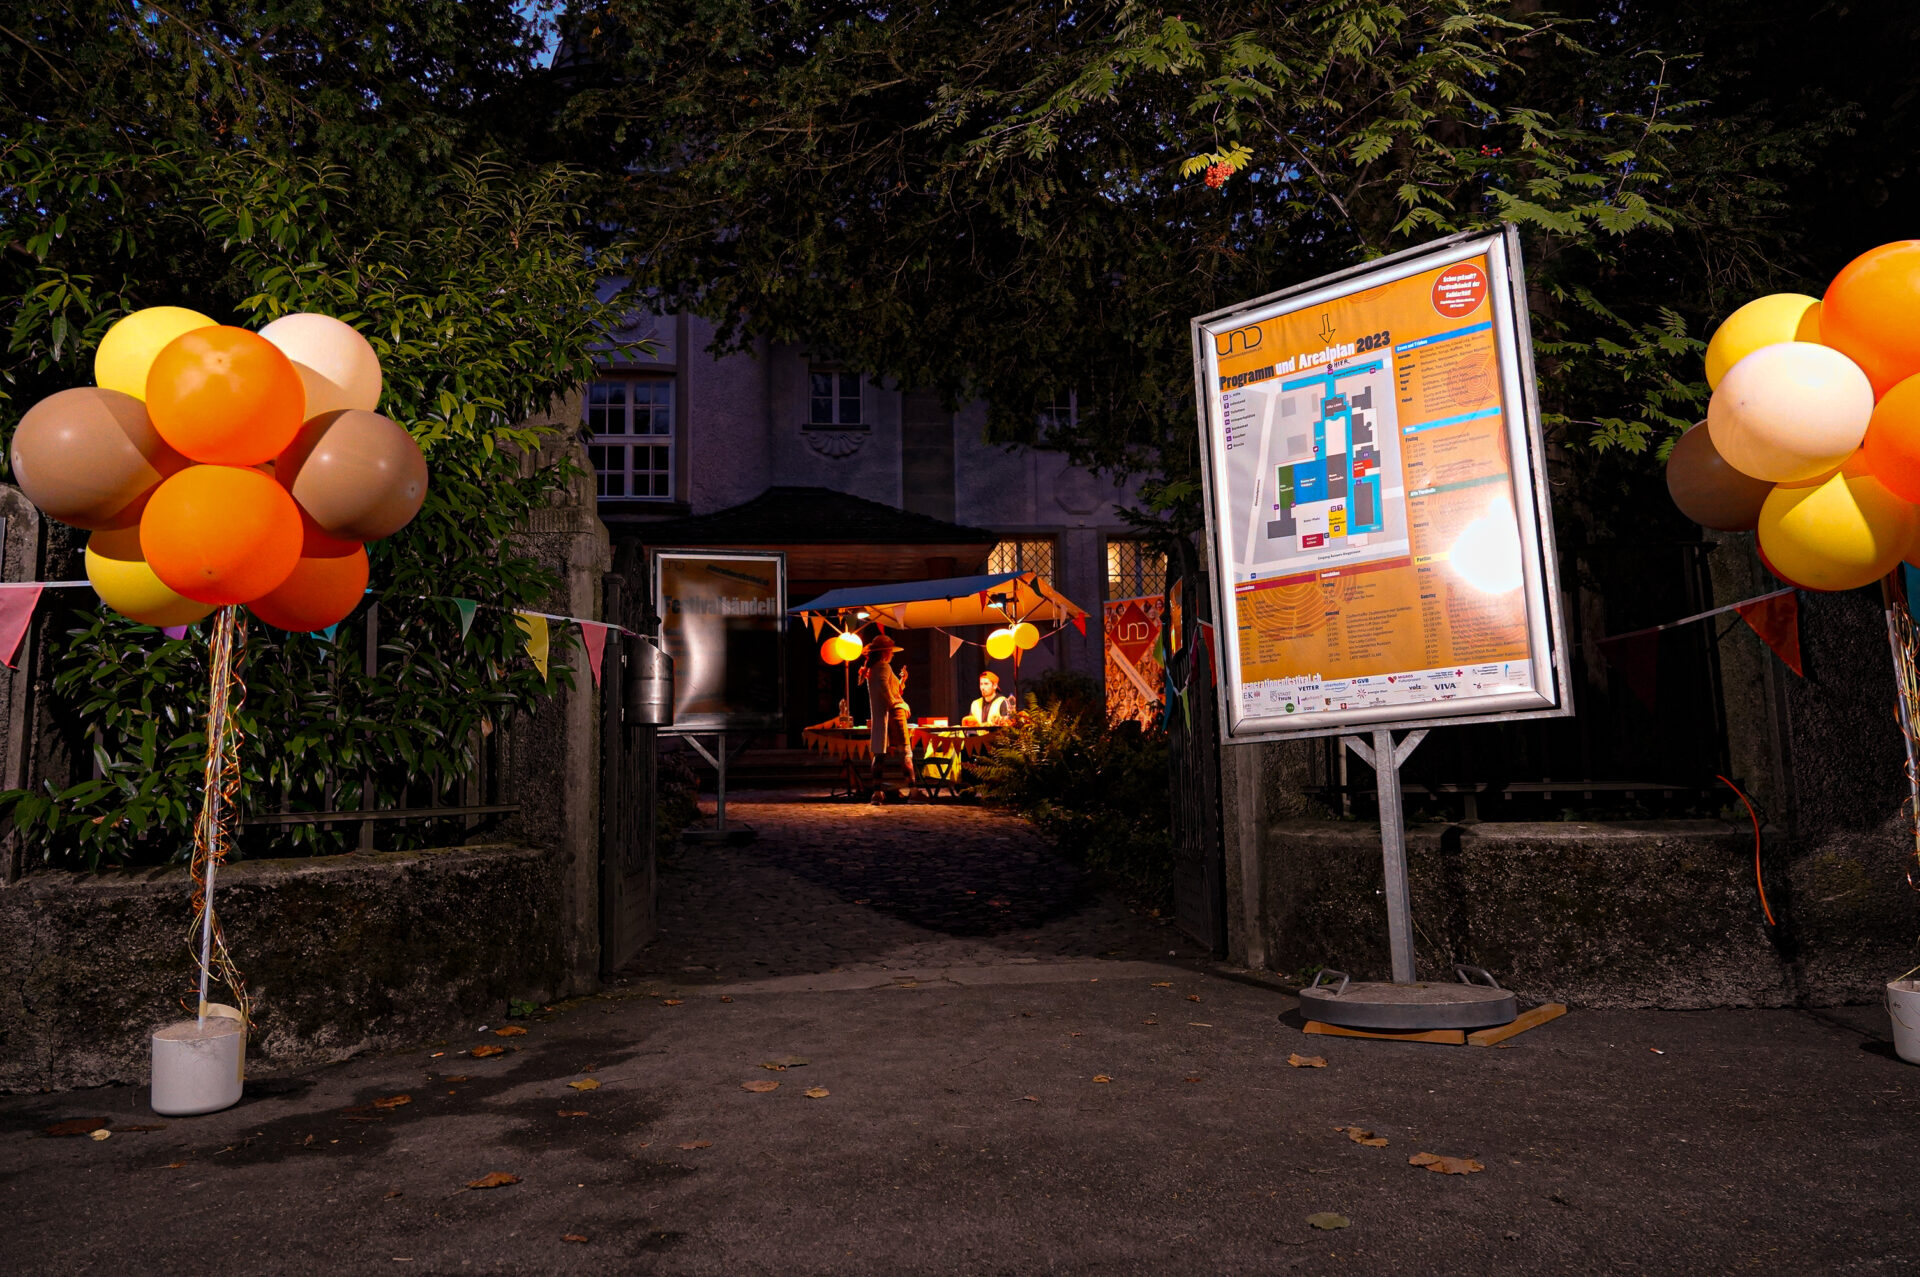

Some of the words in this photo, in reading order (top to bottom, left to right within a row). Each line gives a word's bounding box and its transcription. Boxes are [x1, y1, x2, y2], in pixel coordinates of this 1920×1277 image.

[1220, 365, 1274, 390] Programm
[1275, 356, 1296, 375] und
[1298, 343, 1355, 370] Arealplan
[1356, 331, 1390, 353] 2023
